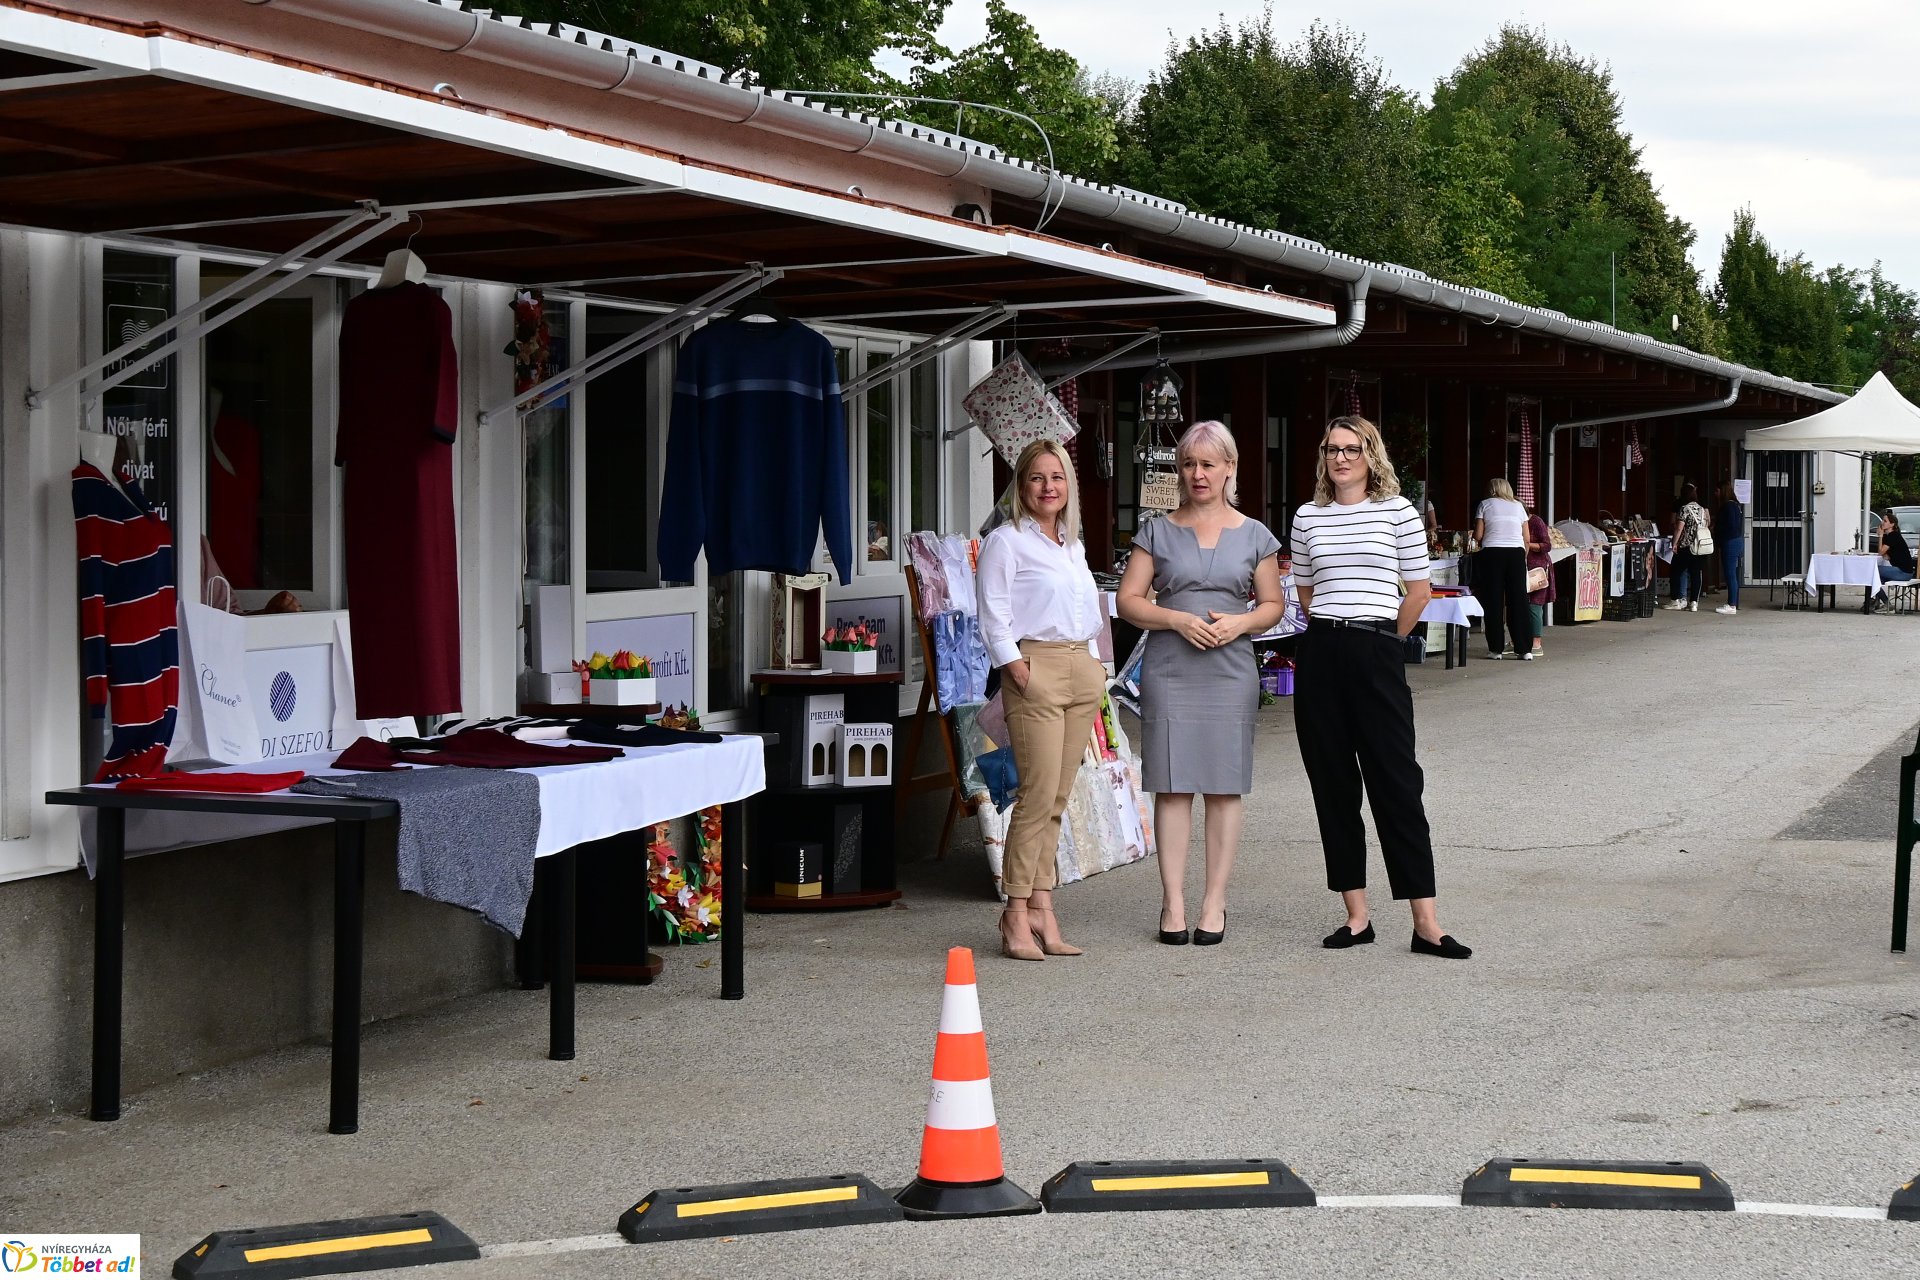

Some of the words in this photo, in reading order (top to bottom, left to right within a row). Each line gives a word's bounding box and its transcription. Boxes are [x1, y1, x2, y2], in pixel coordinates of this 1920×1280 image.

[142, 417, 168, 437] férfi
[122, 460, 154, 479] divat
[1146, 486, 1177, 496] SWEET
[1145, 496, 1175, 507] HOME
[674, 649, 690, 676] Kft.
[878, 644, 896, 664] Kft.
[810, 710, 844, 720] PIREHAB
[845, 727, 893, 737] PIREHAB
[279, 730, 323, 755] SZEFO
